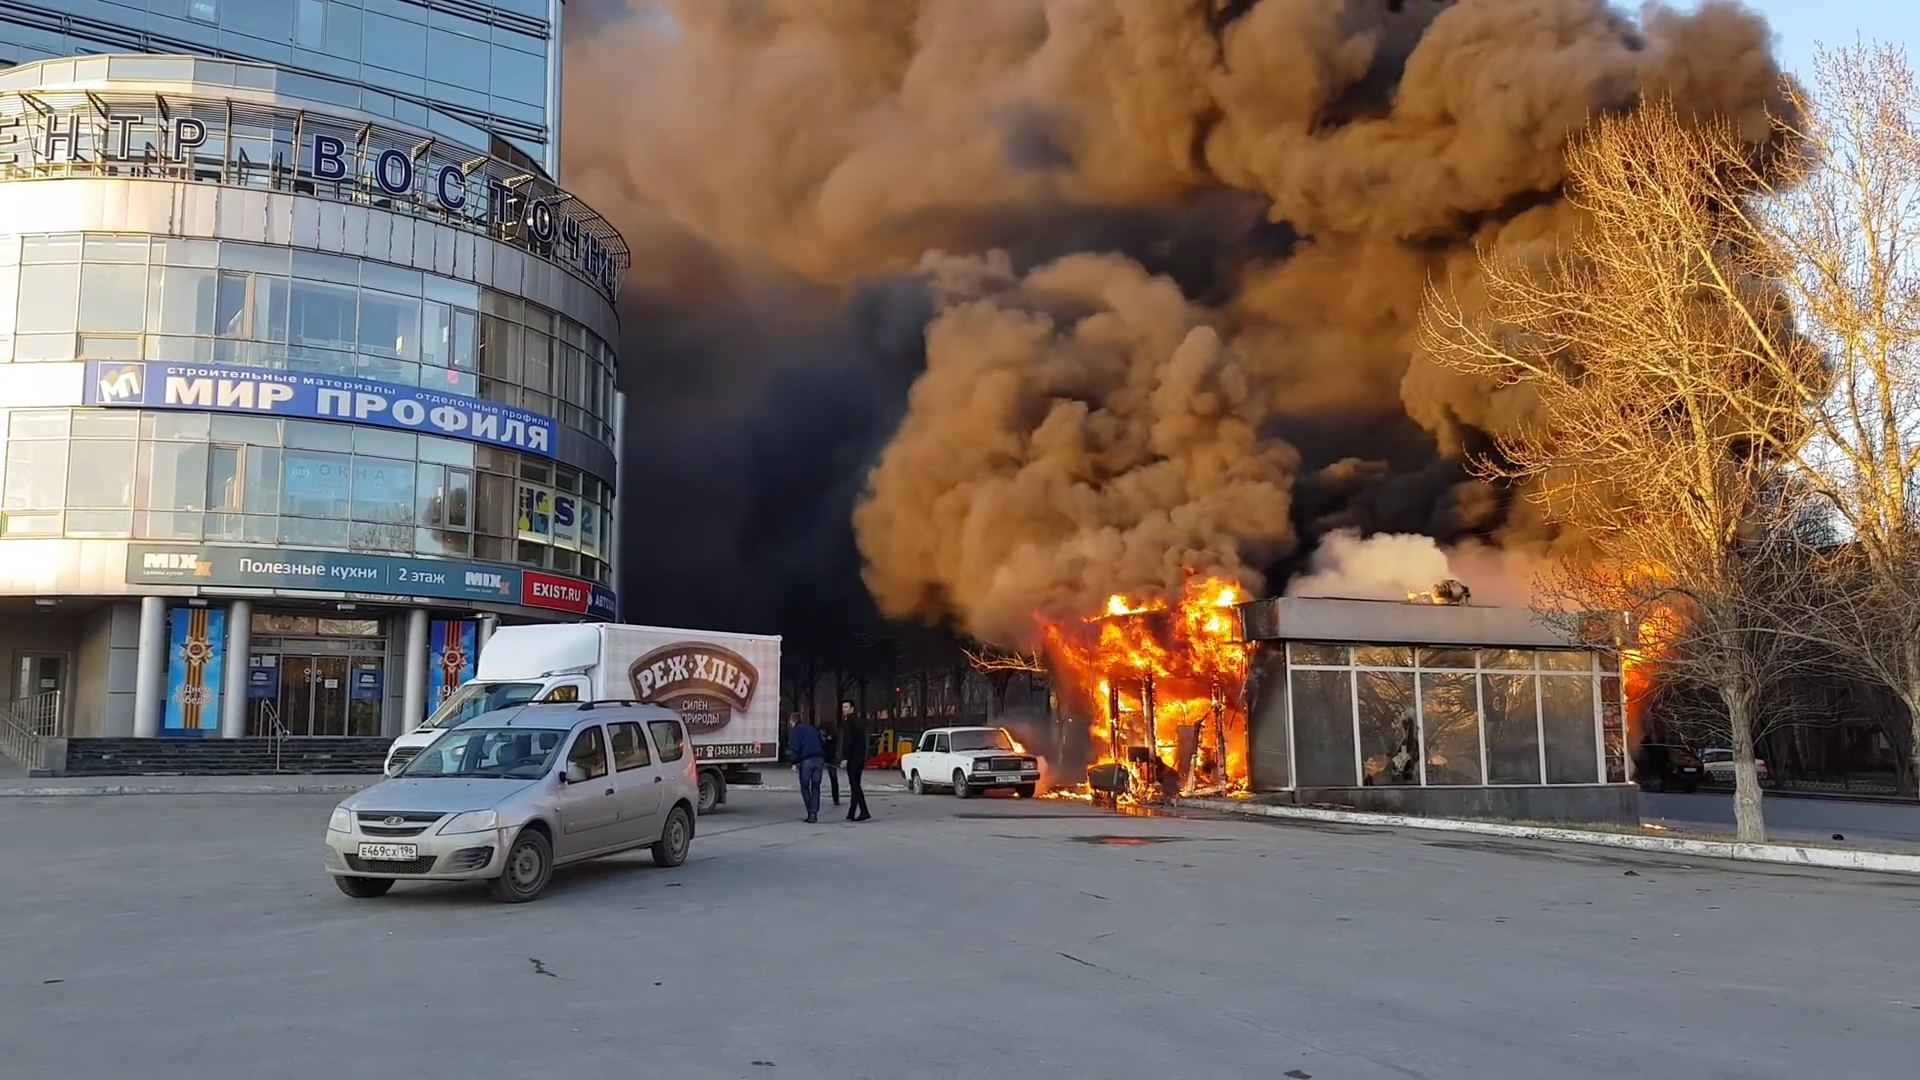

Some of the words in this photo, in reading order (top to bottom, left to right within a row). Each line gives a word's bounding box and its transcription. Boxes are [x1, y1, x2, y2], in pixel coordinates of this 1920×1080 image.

[167, 366, 297, 384] строительные
[303, 376, 396, 396] материалы
[415, 391, 499, 415] отделочные
[502, 409, 550, 428] профили
[165, 376, 294, 410] МИР
[317, 388, 549, 452] ПРОФИЛЯ
[239, 558, 327, 576] Полезные
[330, 565, 378, 580] кухни
[398, 568, 408, 581] 2
[410, 570, 446, 584] этаж
[533, 582, 581, 602] EXIST.RU
[400, 845, 415, 854] 196
